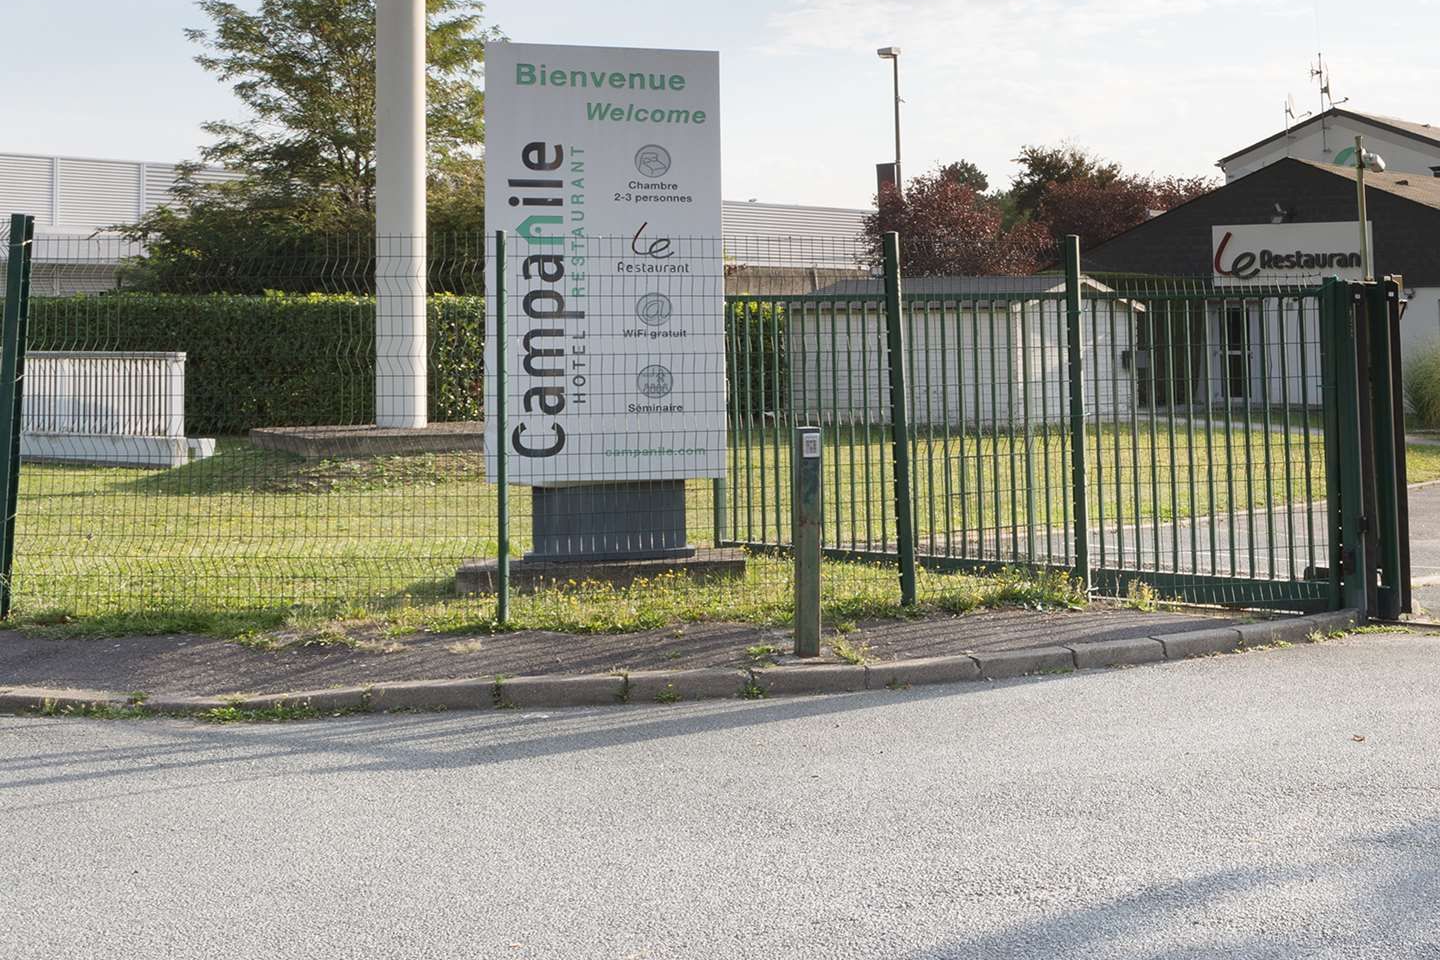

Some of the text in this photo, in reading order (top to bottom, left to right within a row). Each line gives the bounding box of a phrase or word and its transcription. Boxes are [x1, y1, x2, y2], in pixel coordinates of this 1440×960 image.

[515, 63, 686, 91] Bienvenue
[586, 102, 706, 124] Welcome
[628, 180, 678, 190] Chambre
[614, 192, 693, 204] 2-3 personnes
[617, 261, 690, 273] Restaurant
[1259, 249, 1362, 270] Restauran
[570, 145, 586, 404] HOTEL RESTAURANT
[507, 141, 585, 458] Campanile
[650, 329, 687, 340] gratuit
